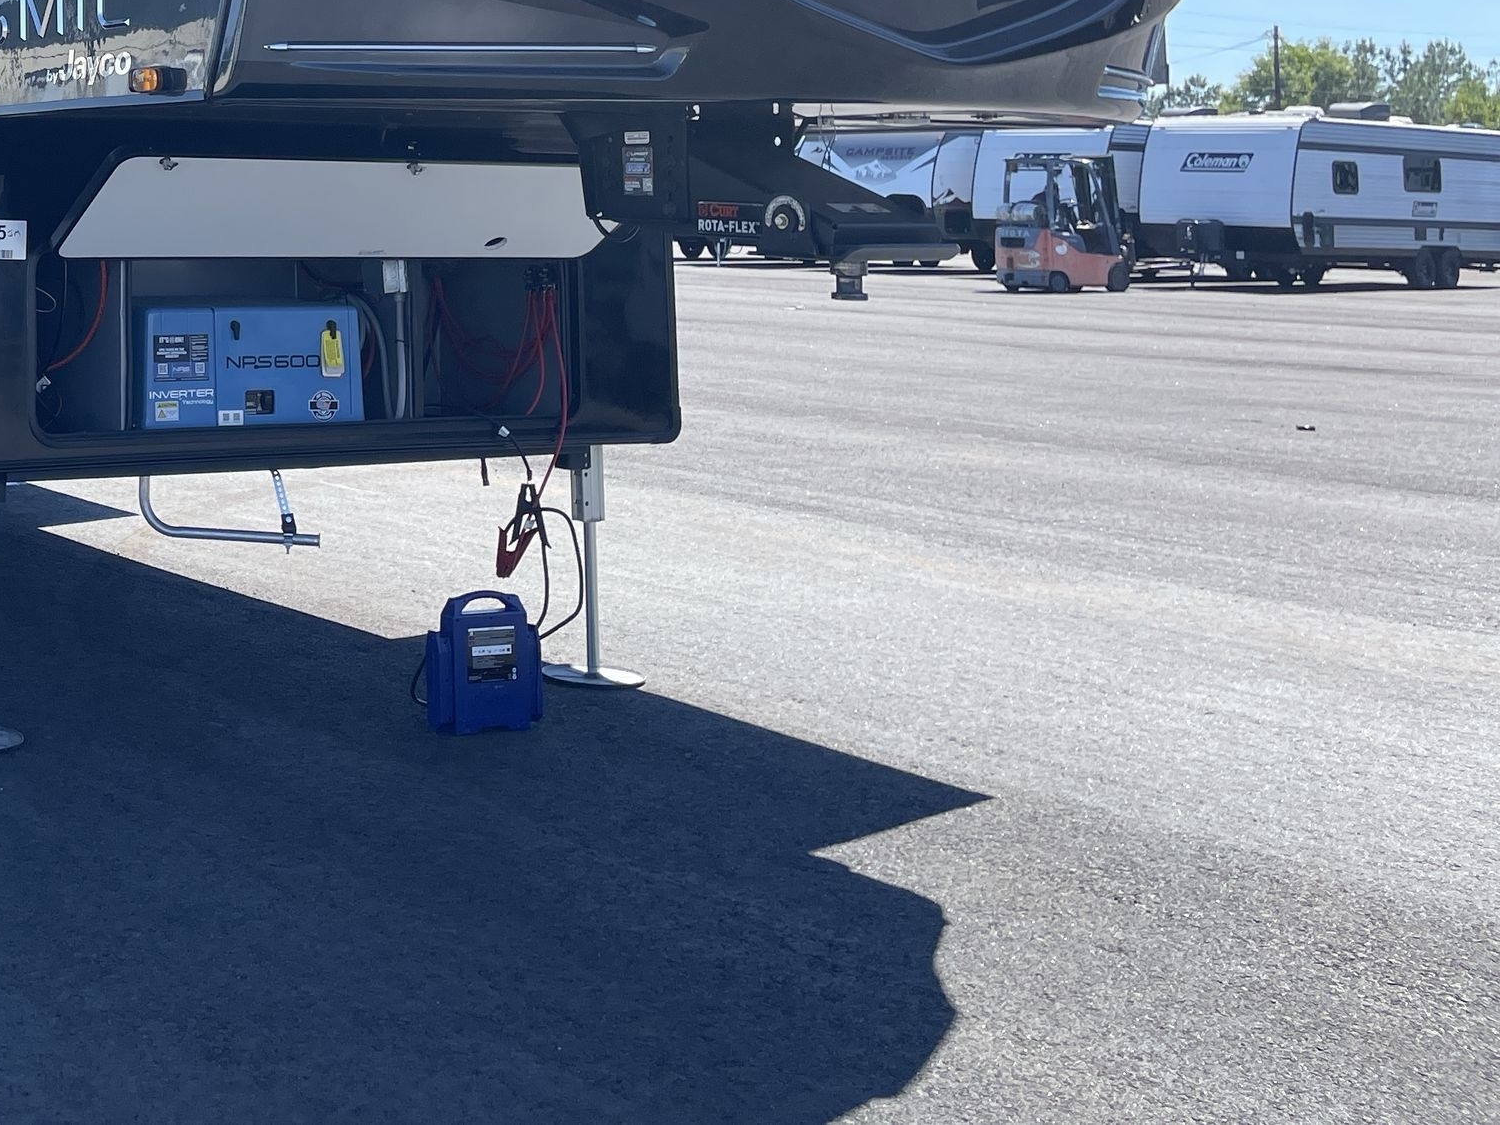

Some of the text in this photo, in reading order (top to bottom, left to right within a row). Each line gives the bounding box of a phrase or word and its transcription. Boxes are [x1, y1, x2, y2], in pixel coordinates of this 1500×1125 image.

[46, 49, 132, 86] by Jayco
[1186, 153, 1238, 168] Coleman
[149, 388, 214, 400] INVERTER
